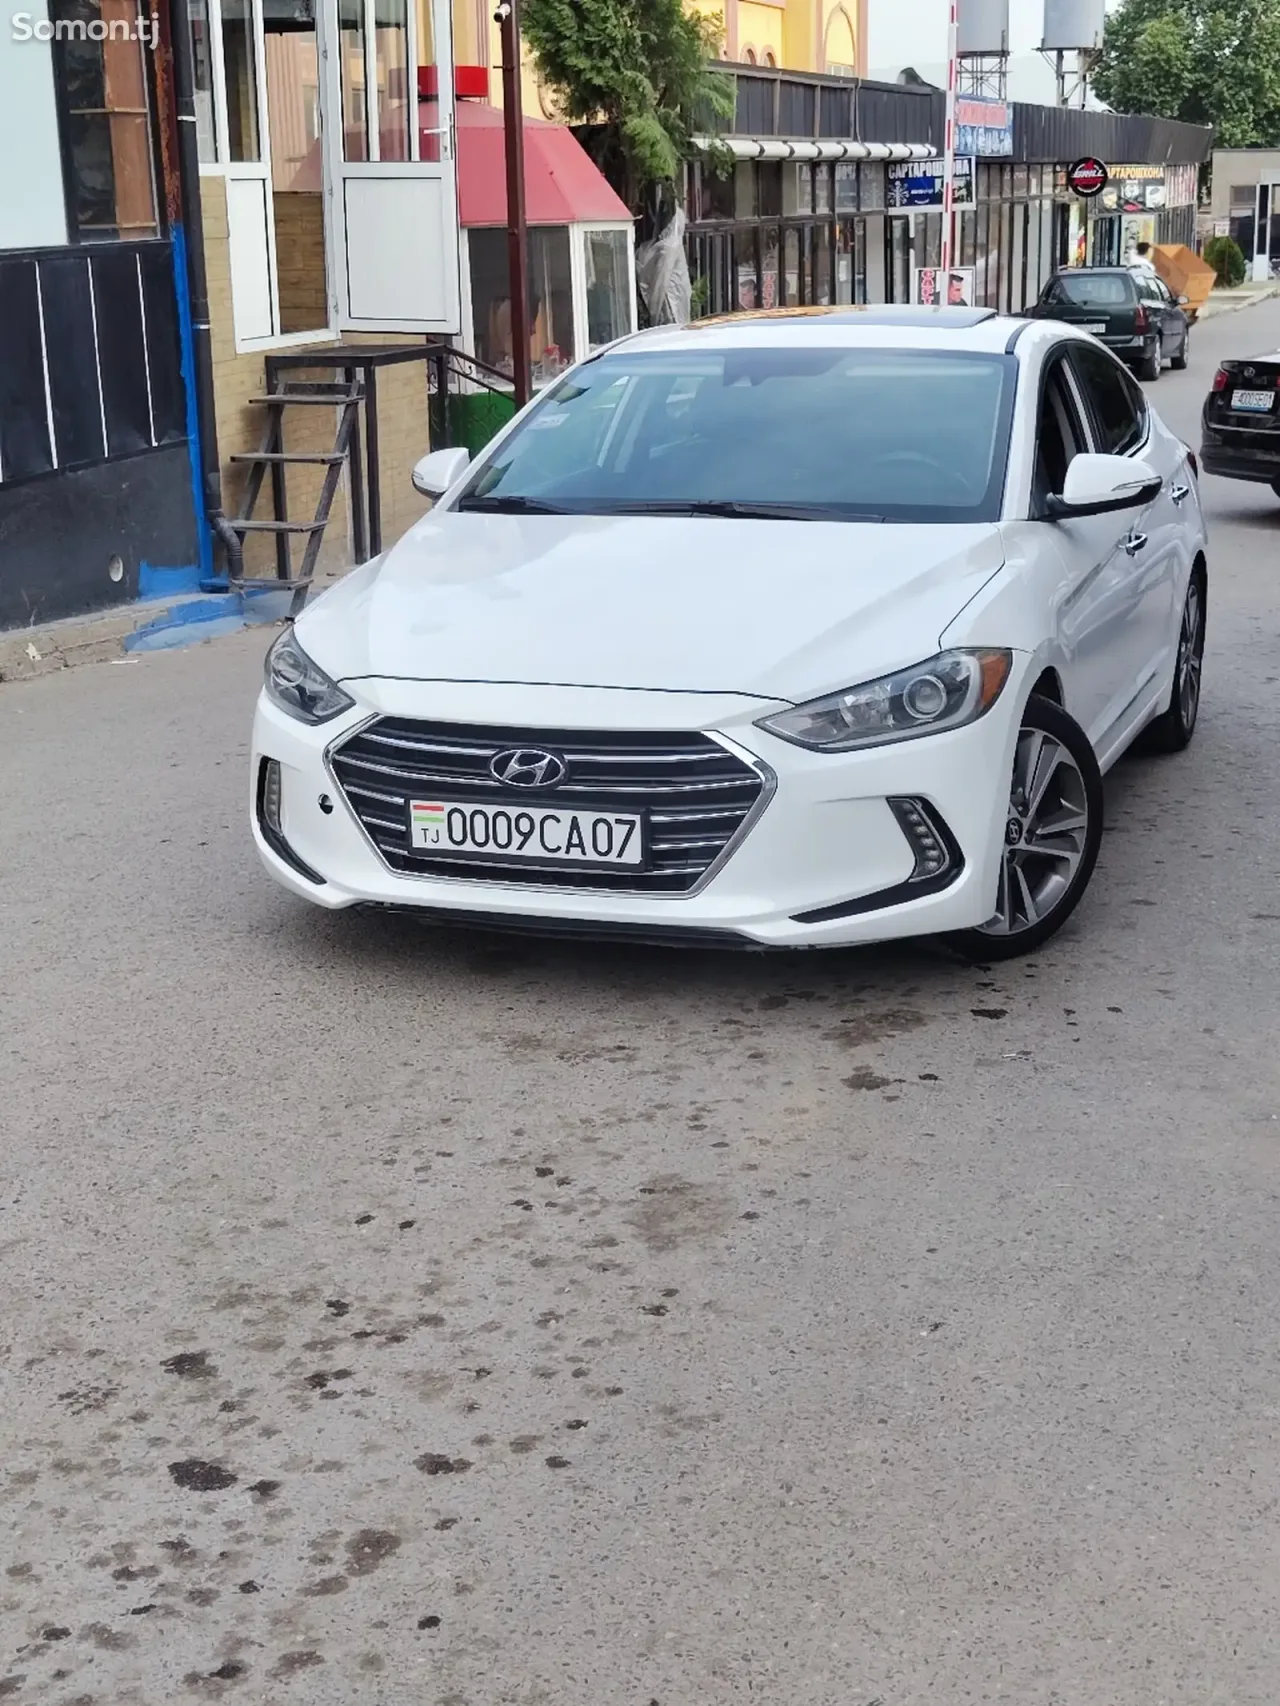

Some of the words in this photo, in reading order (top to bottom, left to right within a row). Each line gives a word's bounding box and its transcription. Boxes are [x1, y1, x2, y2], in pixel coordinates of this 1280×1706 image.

[888, 160, 970, 180] САРТАРОШНА
[420, 828, 440, 844] TJ
[447, 807, 637, 859] 0009CA07
